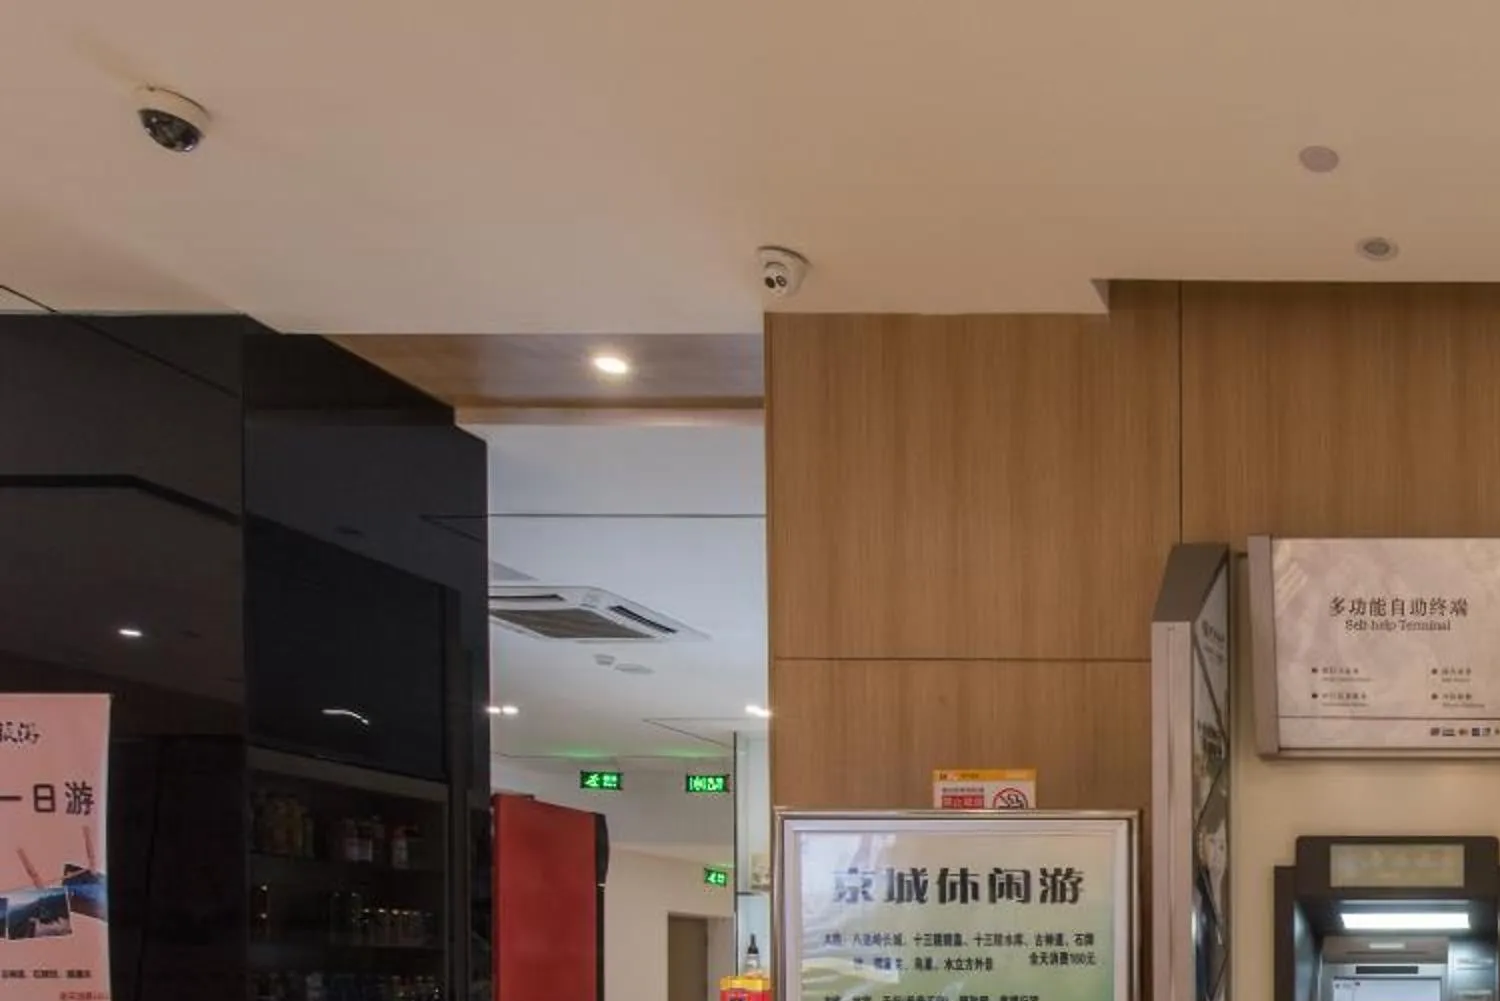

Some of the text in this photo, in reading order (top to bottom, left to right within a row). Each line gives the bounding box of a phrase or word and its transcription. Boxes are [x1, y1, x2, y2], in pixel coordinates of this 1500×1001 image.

[1329, 597, 1467, 617] 多功能自助终端
[833, 867, 1086, 904] 京城休闲游
